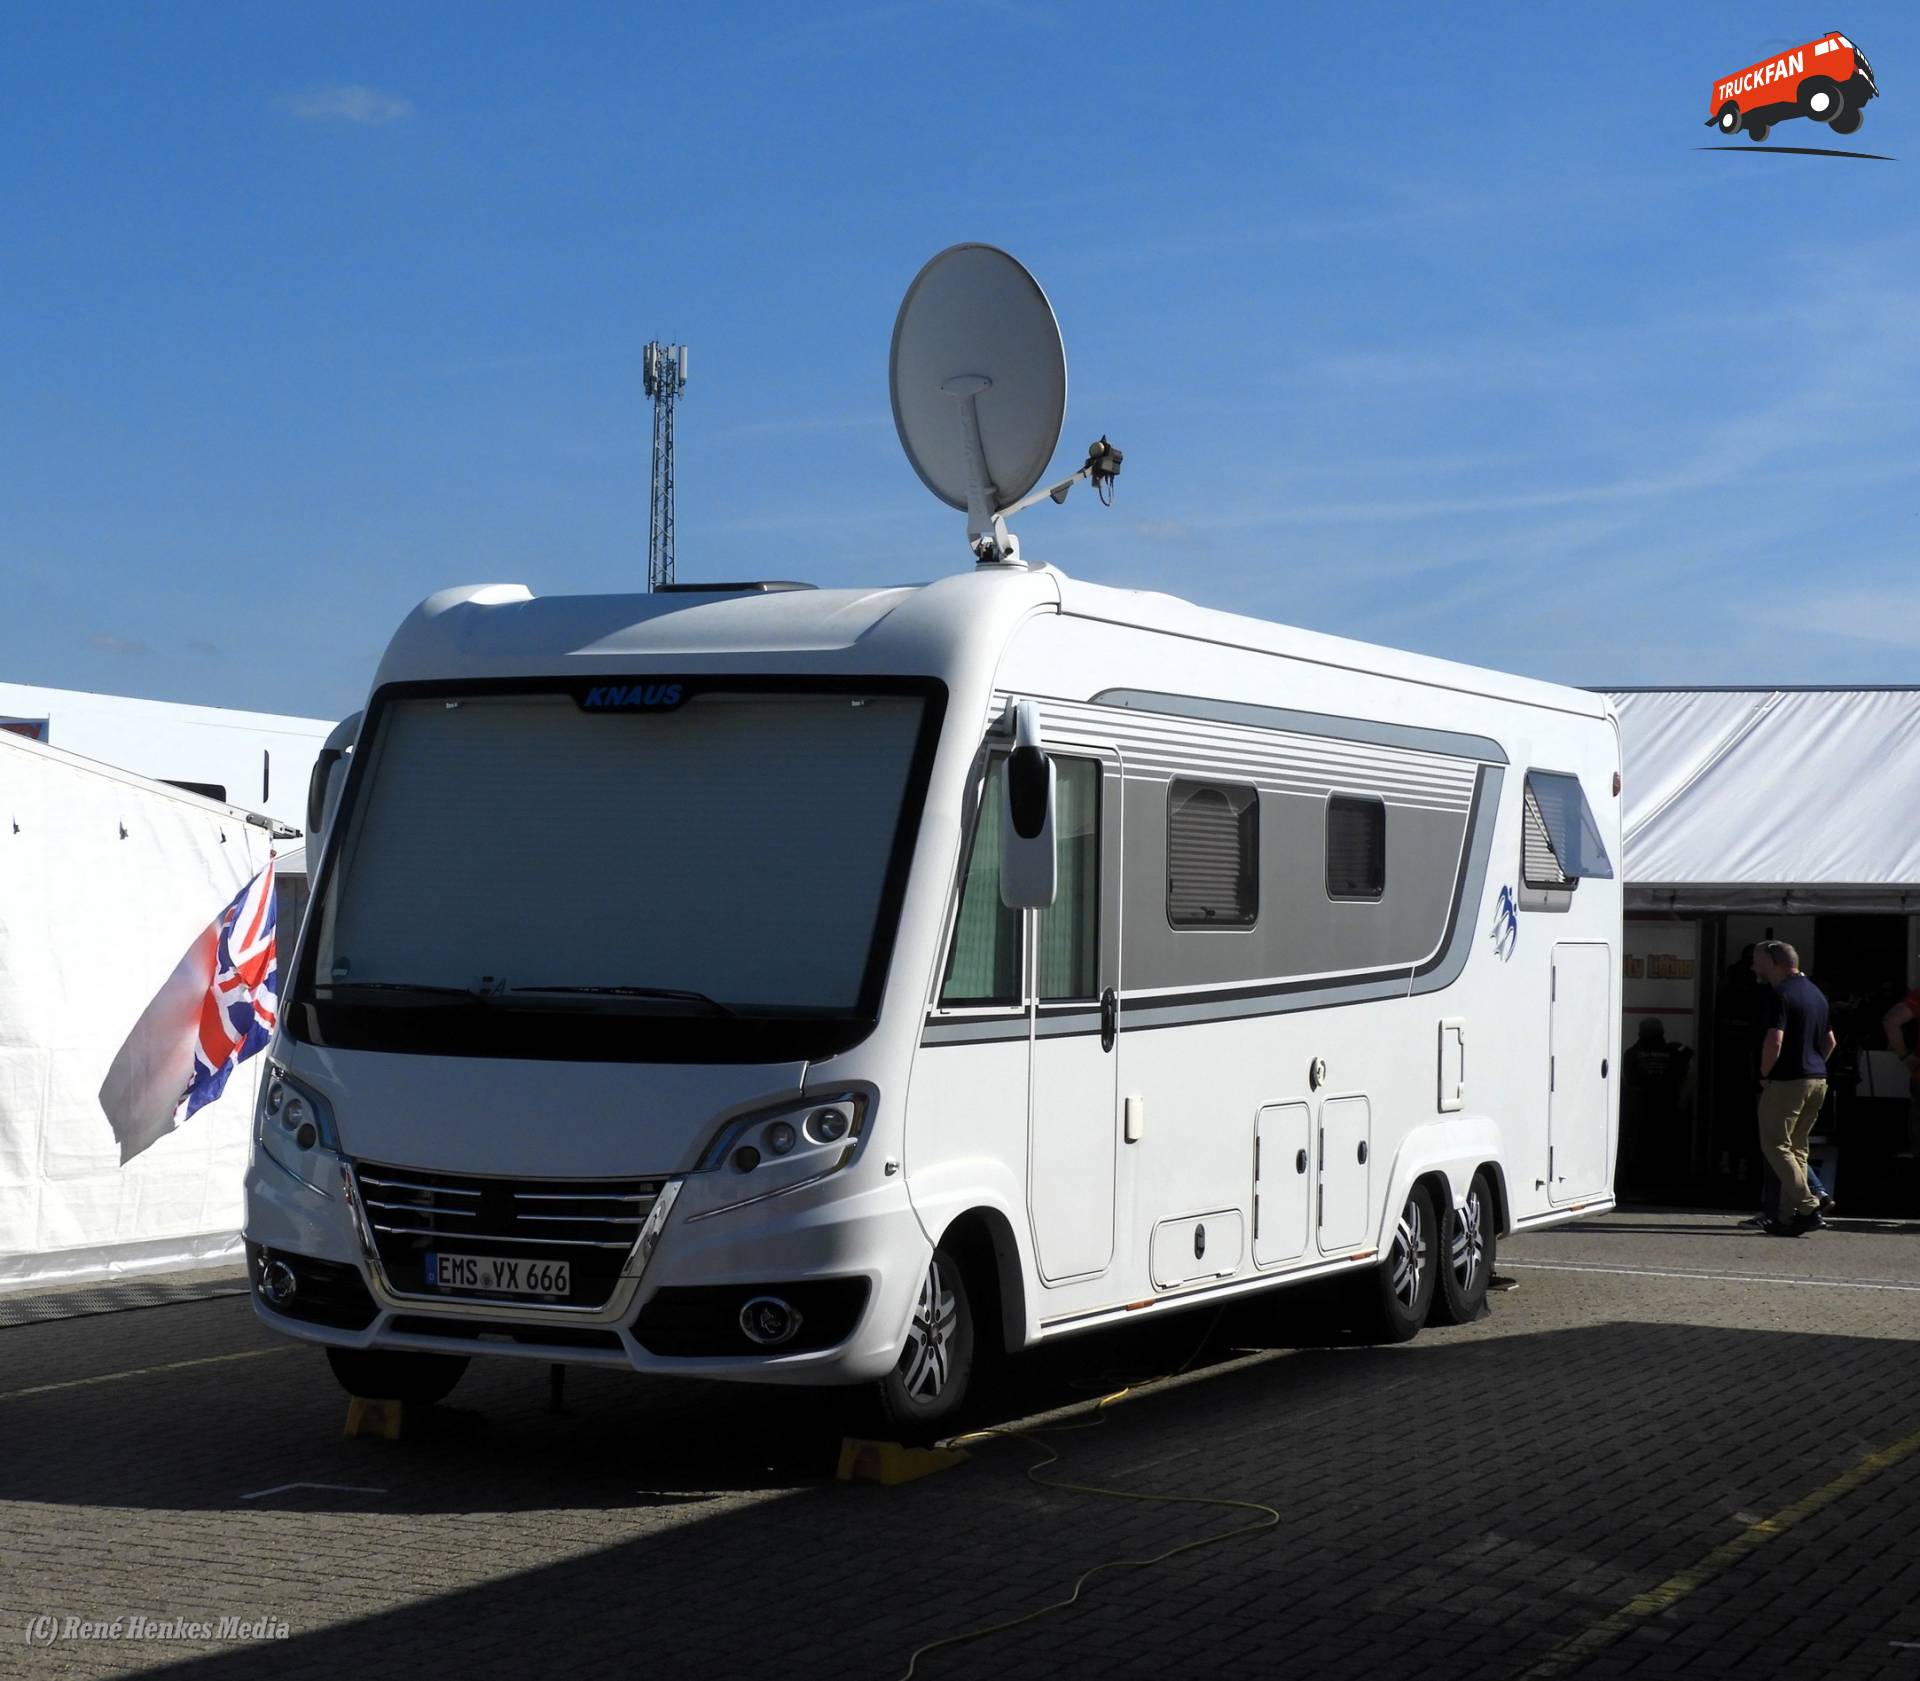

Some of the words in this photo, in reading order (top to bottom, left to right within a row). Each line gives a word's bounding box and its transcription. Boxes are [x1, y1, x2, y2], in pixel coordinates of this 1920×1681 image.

[583, 683, 683, 707] KNAUS
[438, 1257, 478, 1286] EMS
[492, 1261, 519, 1289] YX
[526, 1264, 567, 1292] 666
